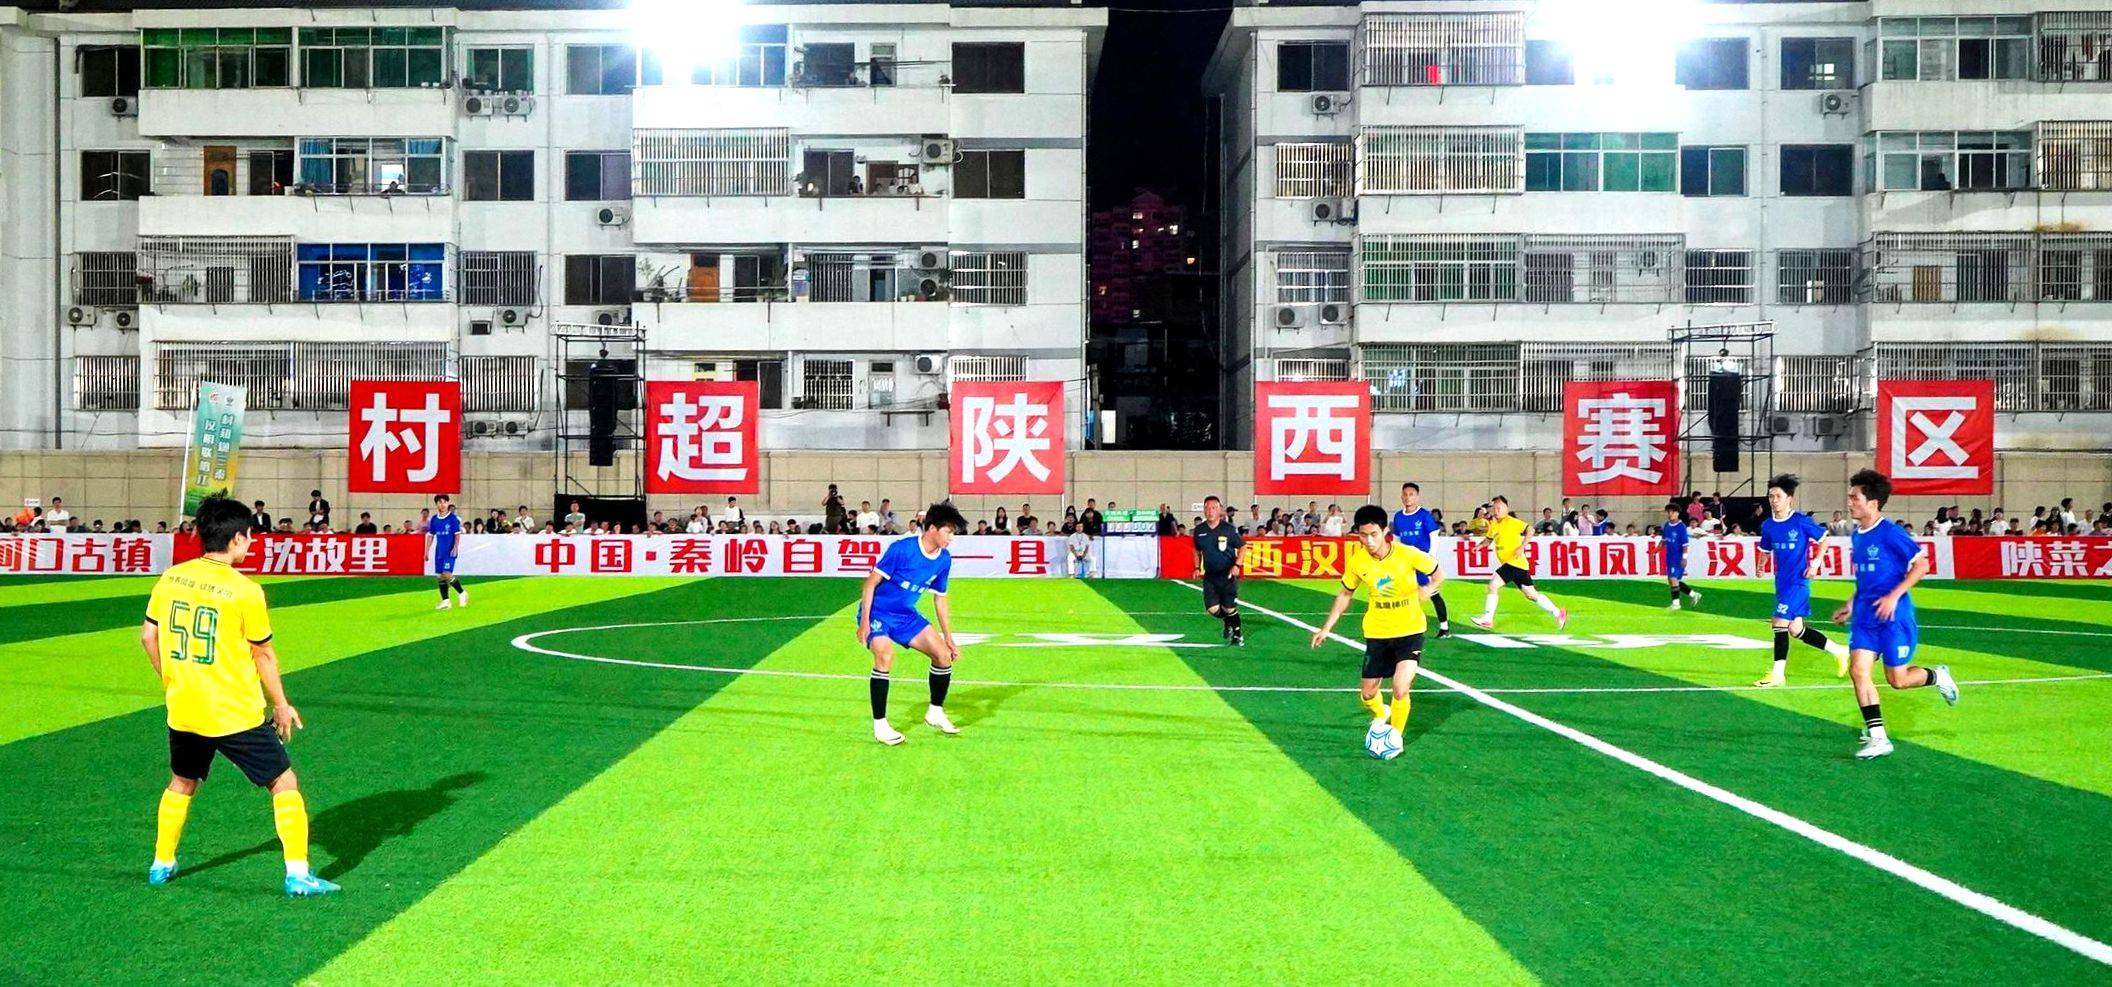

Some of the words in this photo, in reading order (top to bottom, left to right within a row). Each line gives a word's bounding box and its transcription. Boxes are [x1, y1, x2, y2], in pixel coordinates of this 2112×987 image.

[360, 392, 450, 483] 村
[658, 392, 748, 482] 超
[961, 395, 1050, 484] 陕
[1268, 394, 1359, 480] 西
[1577, 393, 1667, 486] 赛
[1892, 396, 1979, 479] 区
[535, 538, 1050, 574] 中国·秦岭自驾一县
[169, 600, 218, 665] 59
